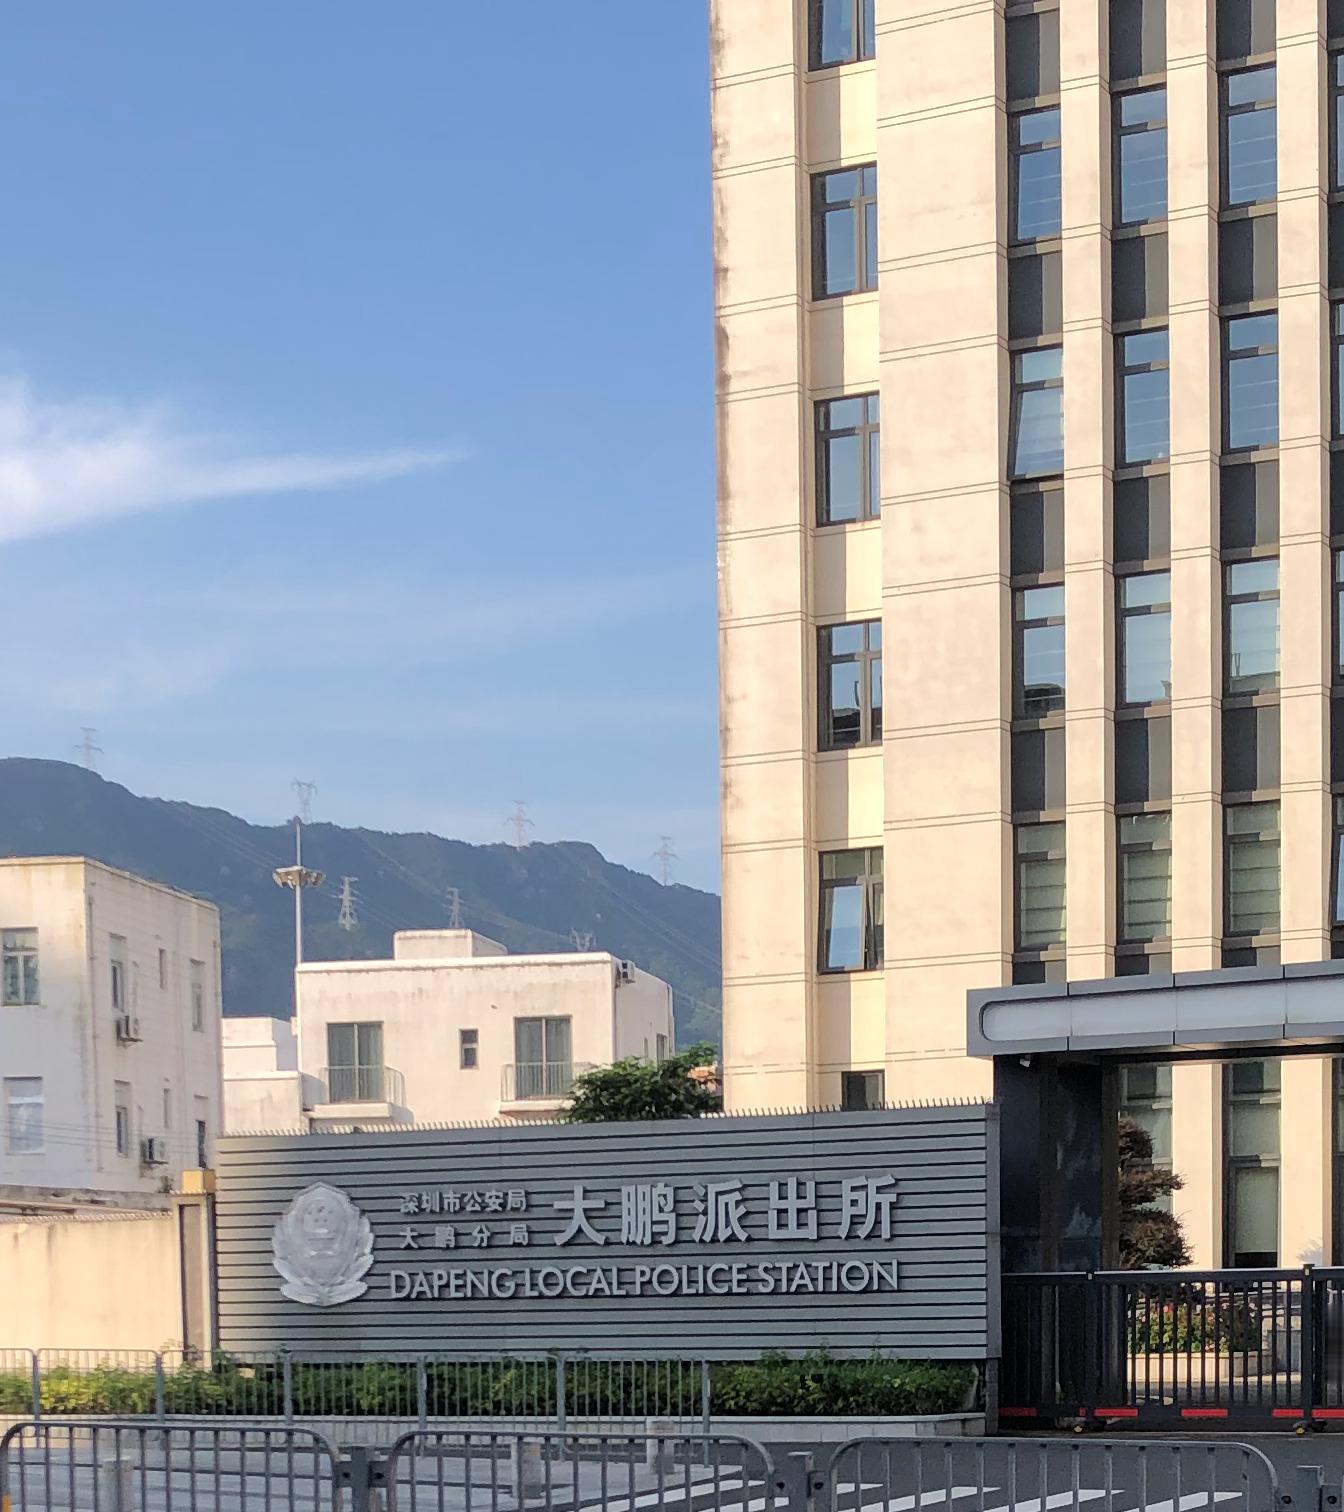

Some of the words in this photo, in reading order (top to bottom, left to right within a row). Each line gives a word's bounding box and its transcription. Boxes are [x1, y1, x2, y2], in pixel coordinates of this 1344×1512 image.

[400, 1188, 527, 1214] 深圳市公安局
[553, 1174, 898, 1246] 大鹏派出所
[400, 1223, 529, 1249] 大鹏分局
[391, 1268, 517, 1298] DAPENG
[525, 1266, 626, 1297] LOCAL
[635, 1263, 748, 1295] POLICE
[757, 1258, 898, 1293] STATION
